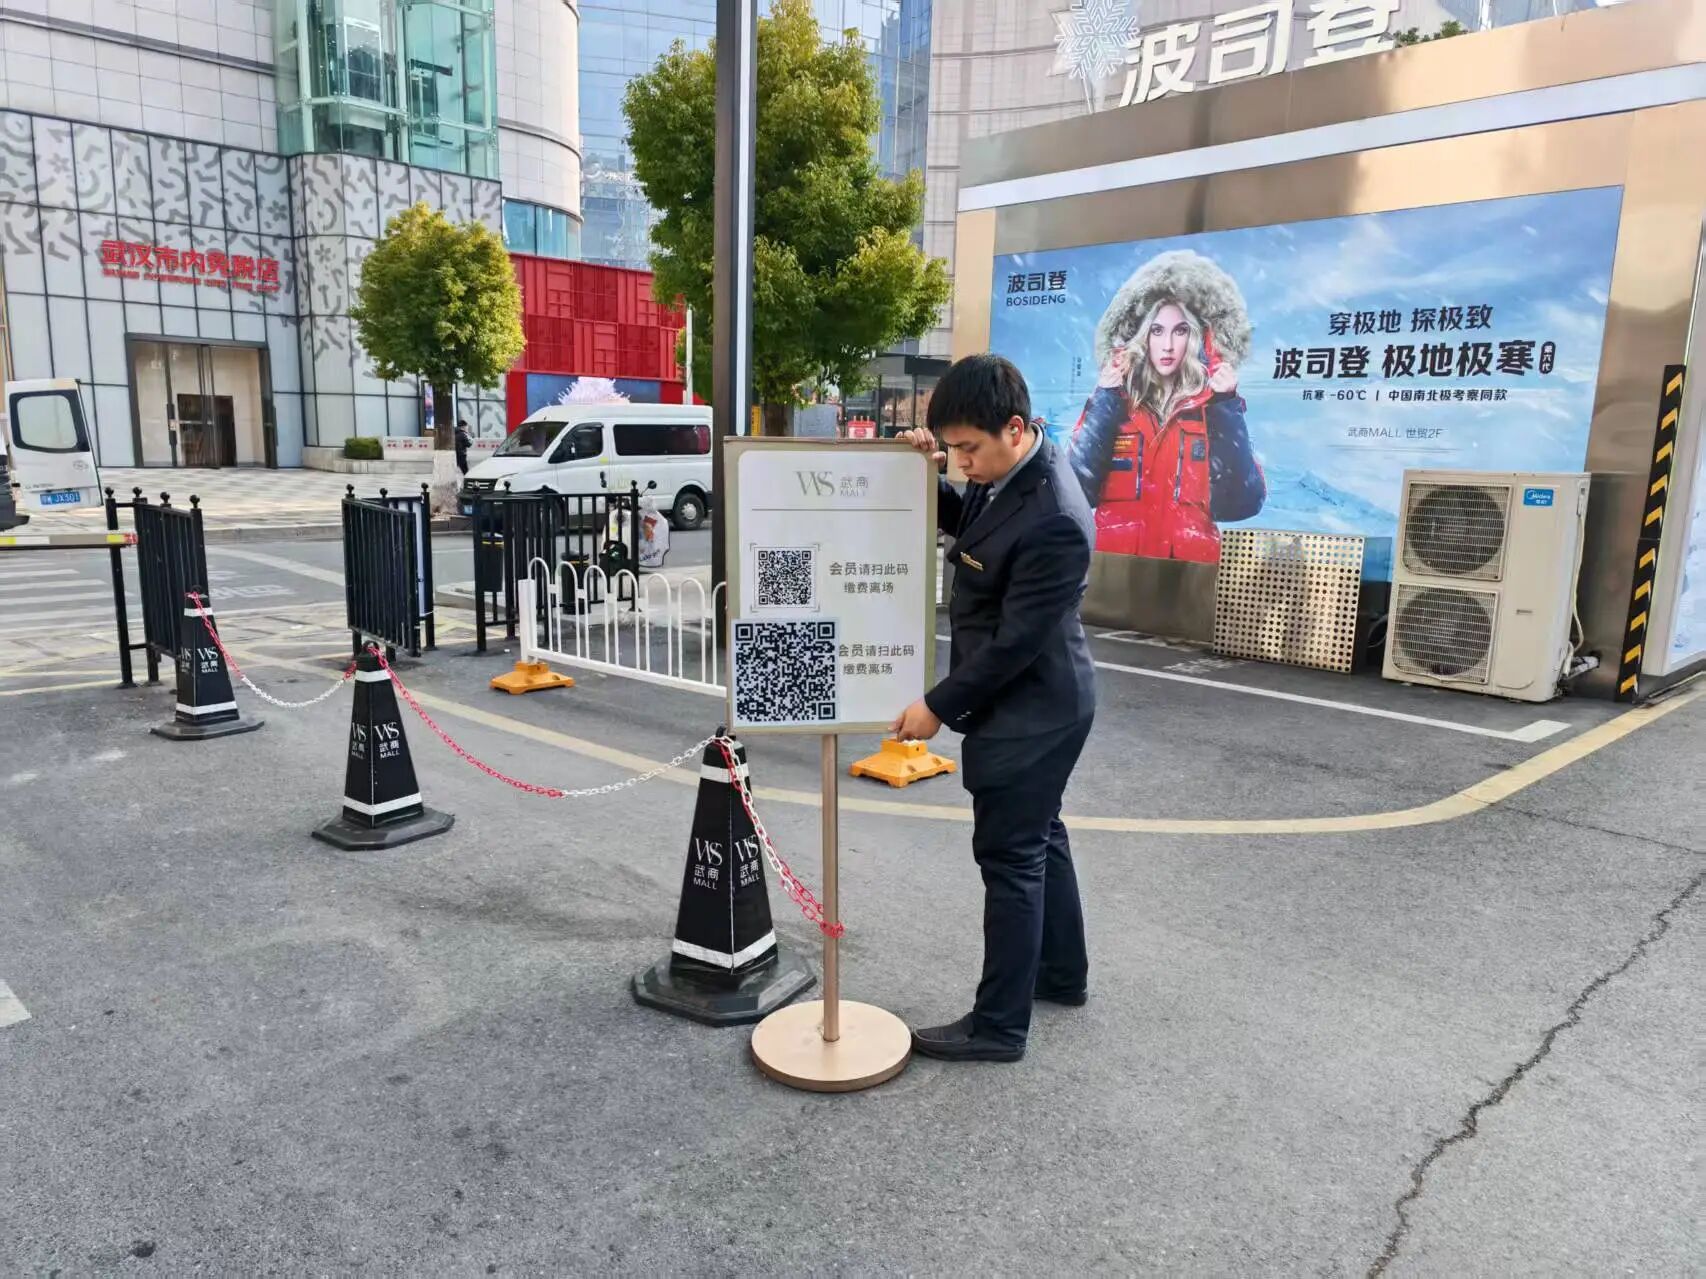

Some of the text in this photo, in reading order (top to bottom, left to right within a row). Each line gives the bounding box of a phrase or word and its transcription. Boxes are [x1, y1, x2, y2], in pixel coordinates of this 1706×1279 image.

[102, 240, 279, 281] 武汉市内免税店
[1007, 270, 1067, 293] 波司登
[1006, 294, 1066, 306] BOSIDENG
[1328, 303, 1494, 336] 穿极地 探极致
[1272, 340, 1536, 379] 波司登 极地极寒
[1303, 390, 1325, 400] 抗寒
[1388, 389, 1508, 401] 中国南北极考察同款
[840, 476, 869, 488] 武商
[829, 562, 909, 576] 会员请扫此码
[844, 581, 894, 594] 缴费离场
[843, 662, 893, 675] 缴费离场
[694, 864, 720, 881] 武商
[693, 877, 719, 890] MALL
[740, 873, 761, 888] MALL
